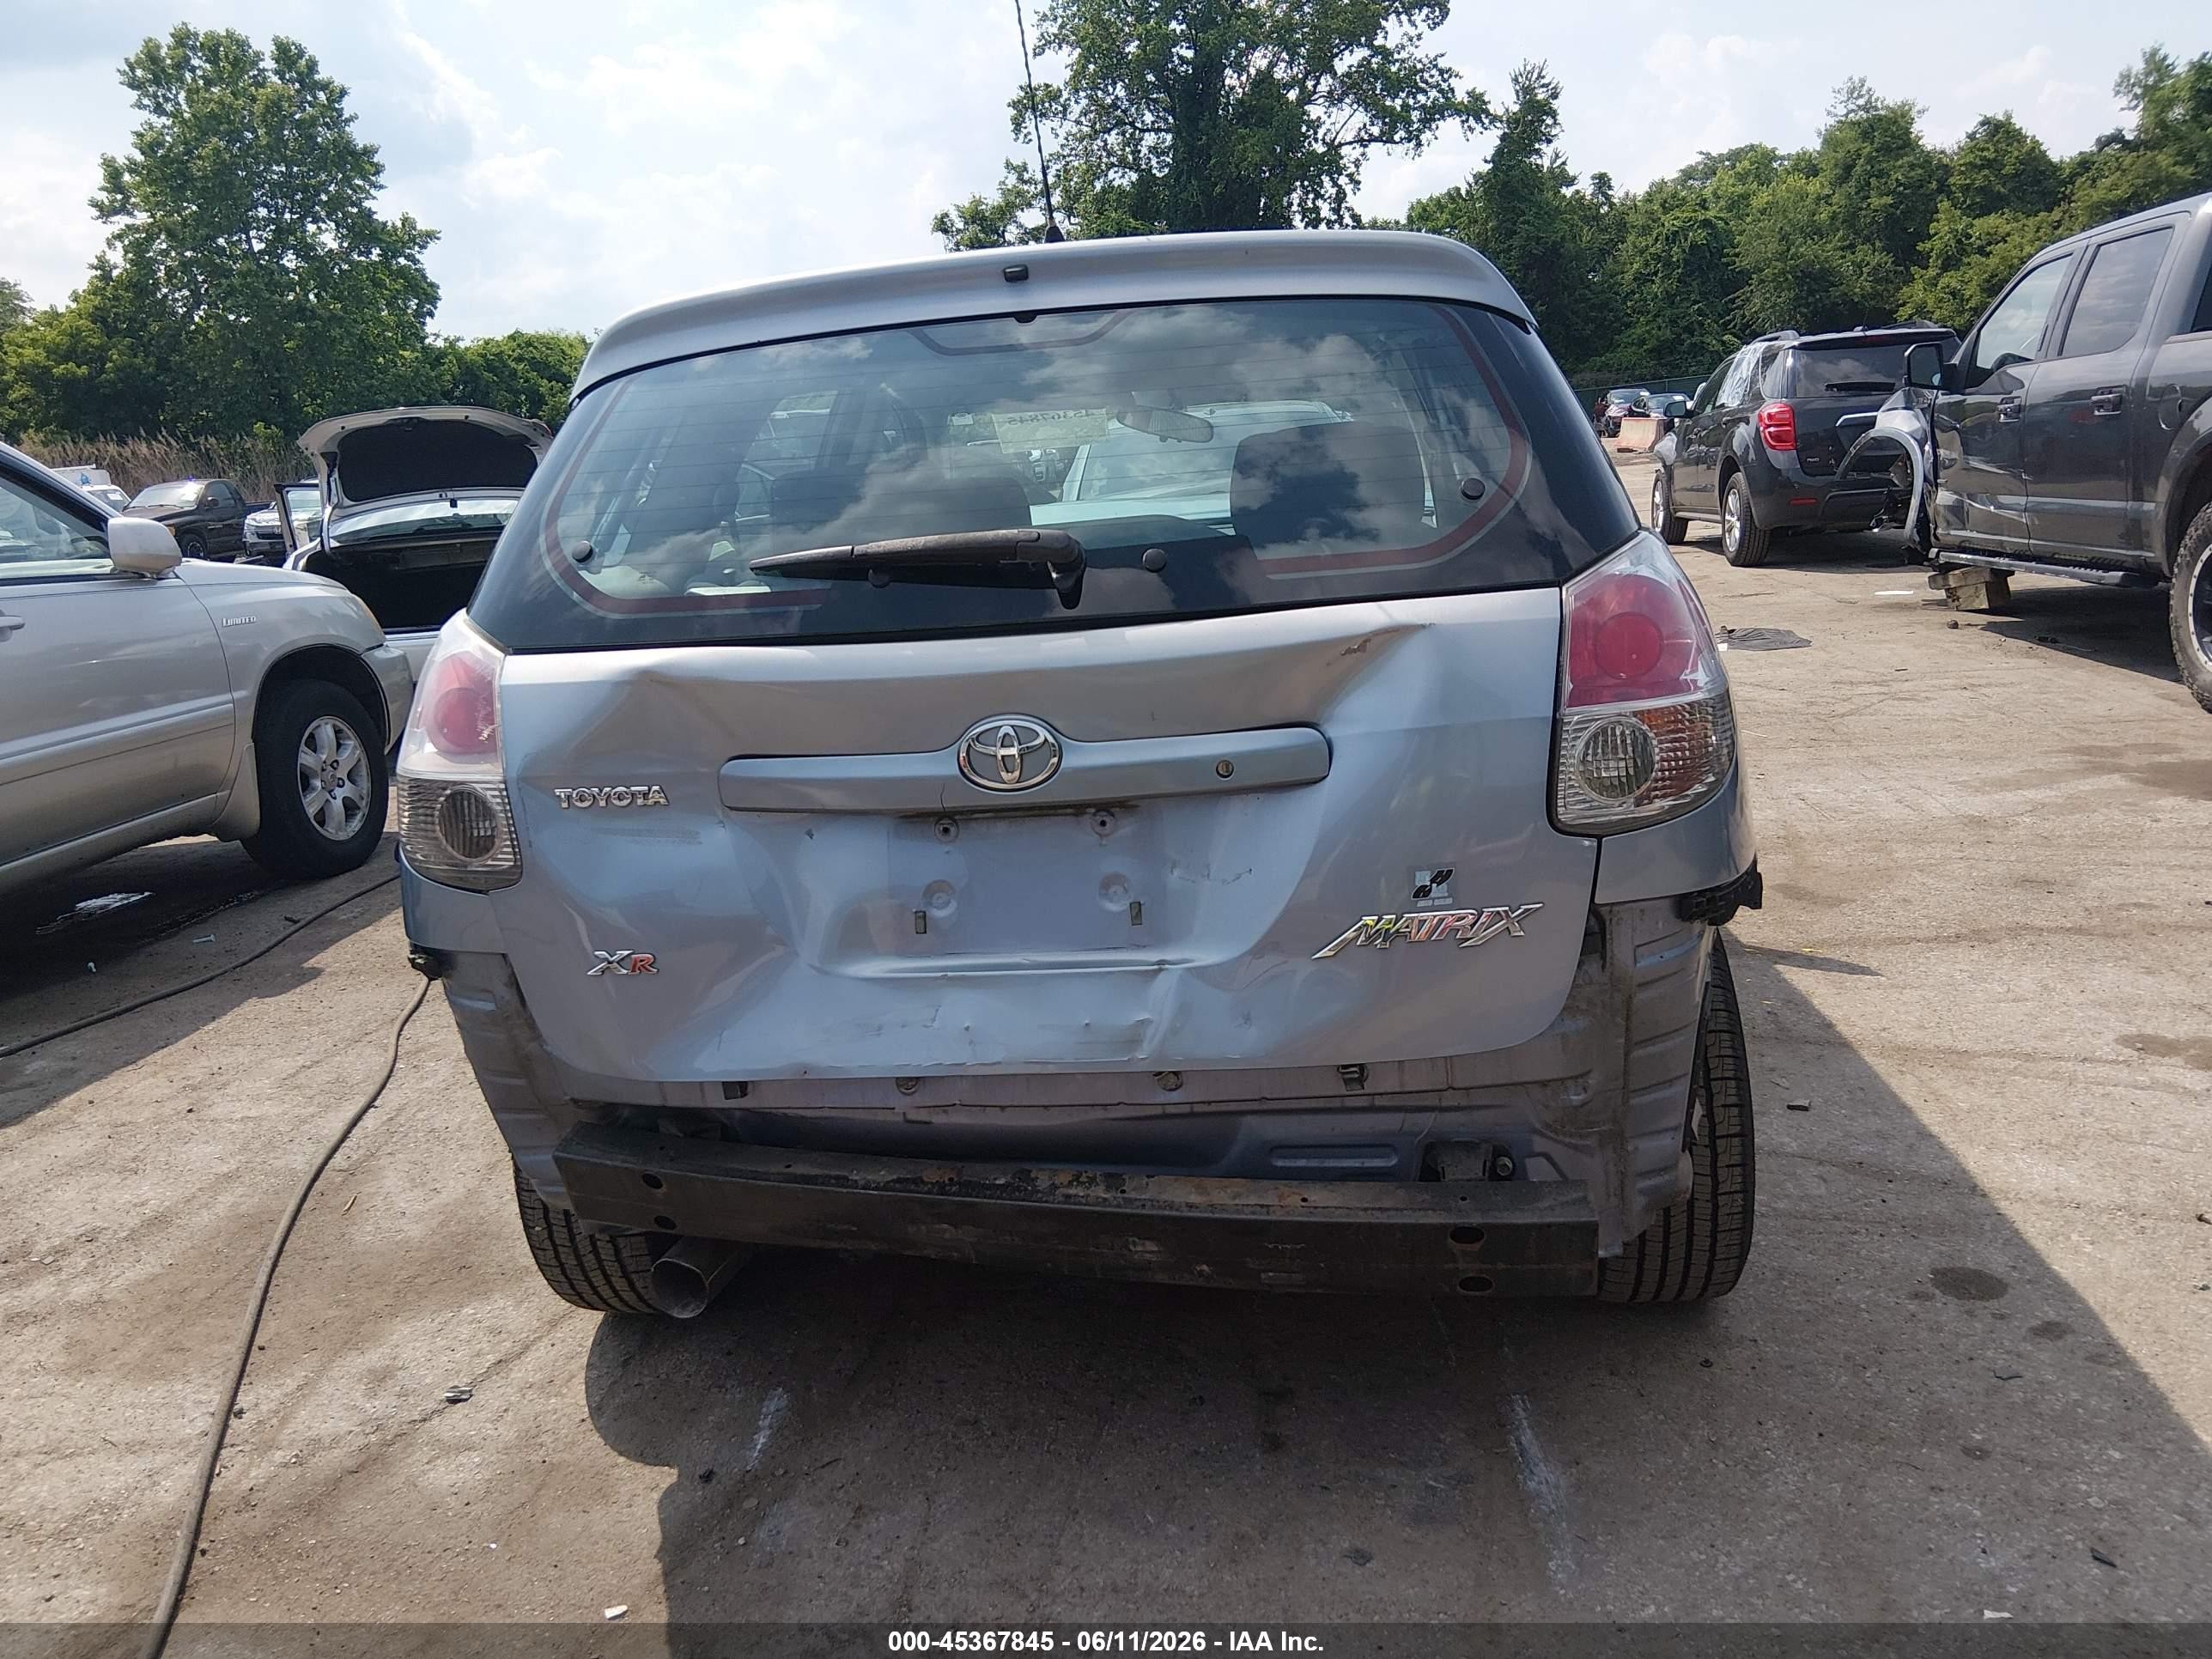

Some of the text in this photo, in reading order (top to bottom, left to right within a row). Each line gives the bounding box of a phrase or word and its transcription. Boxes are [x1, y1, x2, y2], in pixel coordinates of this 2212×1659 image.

[554, 785, 669, 808] TOYOTA
[1311, 903, 1545, 960] MATRIX
[586, 950, 659, 976] XR
